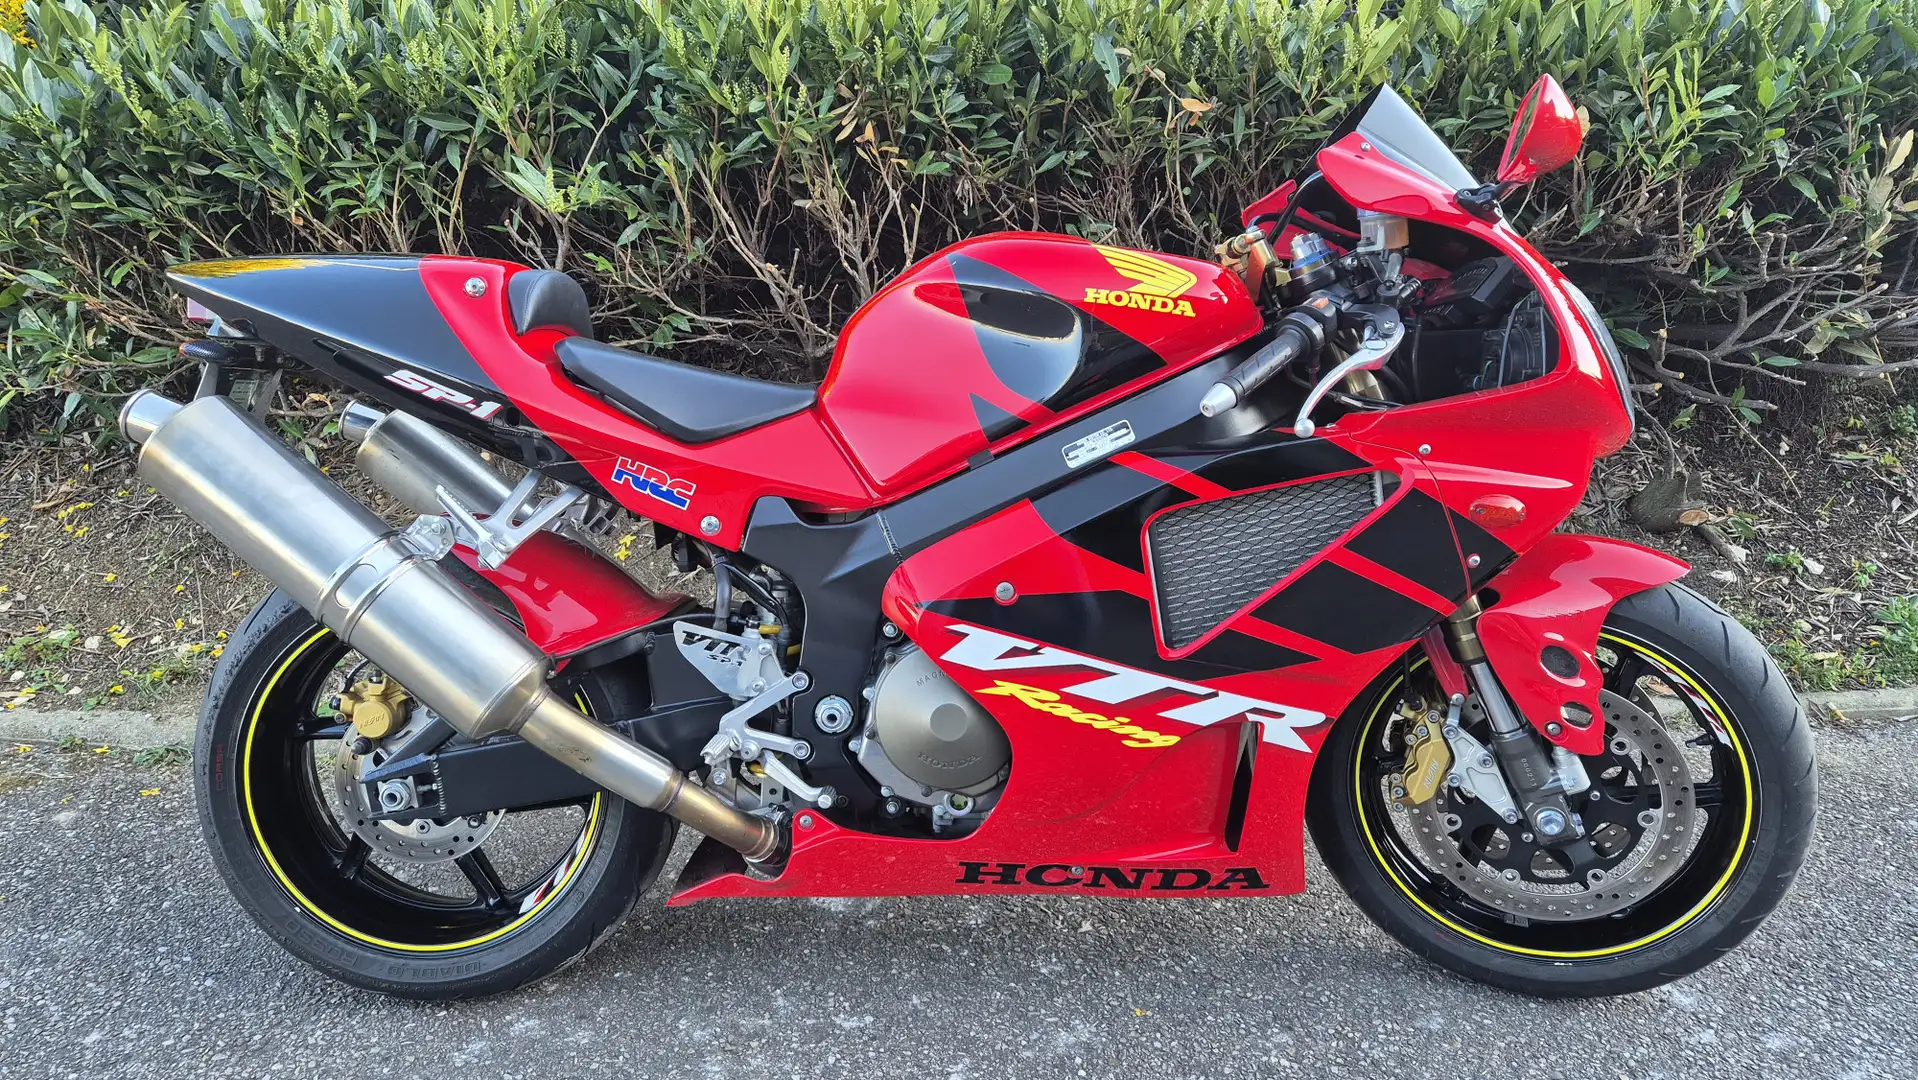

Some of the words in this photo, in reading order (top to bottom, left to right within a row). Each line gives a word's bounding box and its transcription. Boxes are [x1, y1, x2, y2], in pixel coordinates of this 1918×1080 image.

[1083, 287, 1196, 317] HONDA
[383, 369, 504, 421] SP-1
[610, 455, 698, 511] HRC
[939, 623, 1326, 754] VTR
[974, 679, 1182, 749] Racing
[917, 751, 981, 770] HONDA
[955, 860, 1271, 891] HONDA
